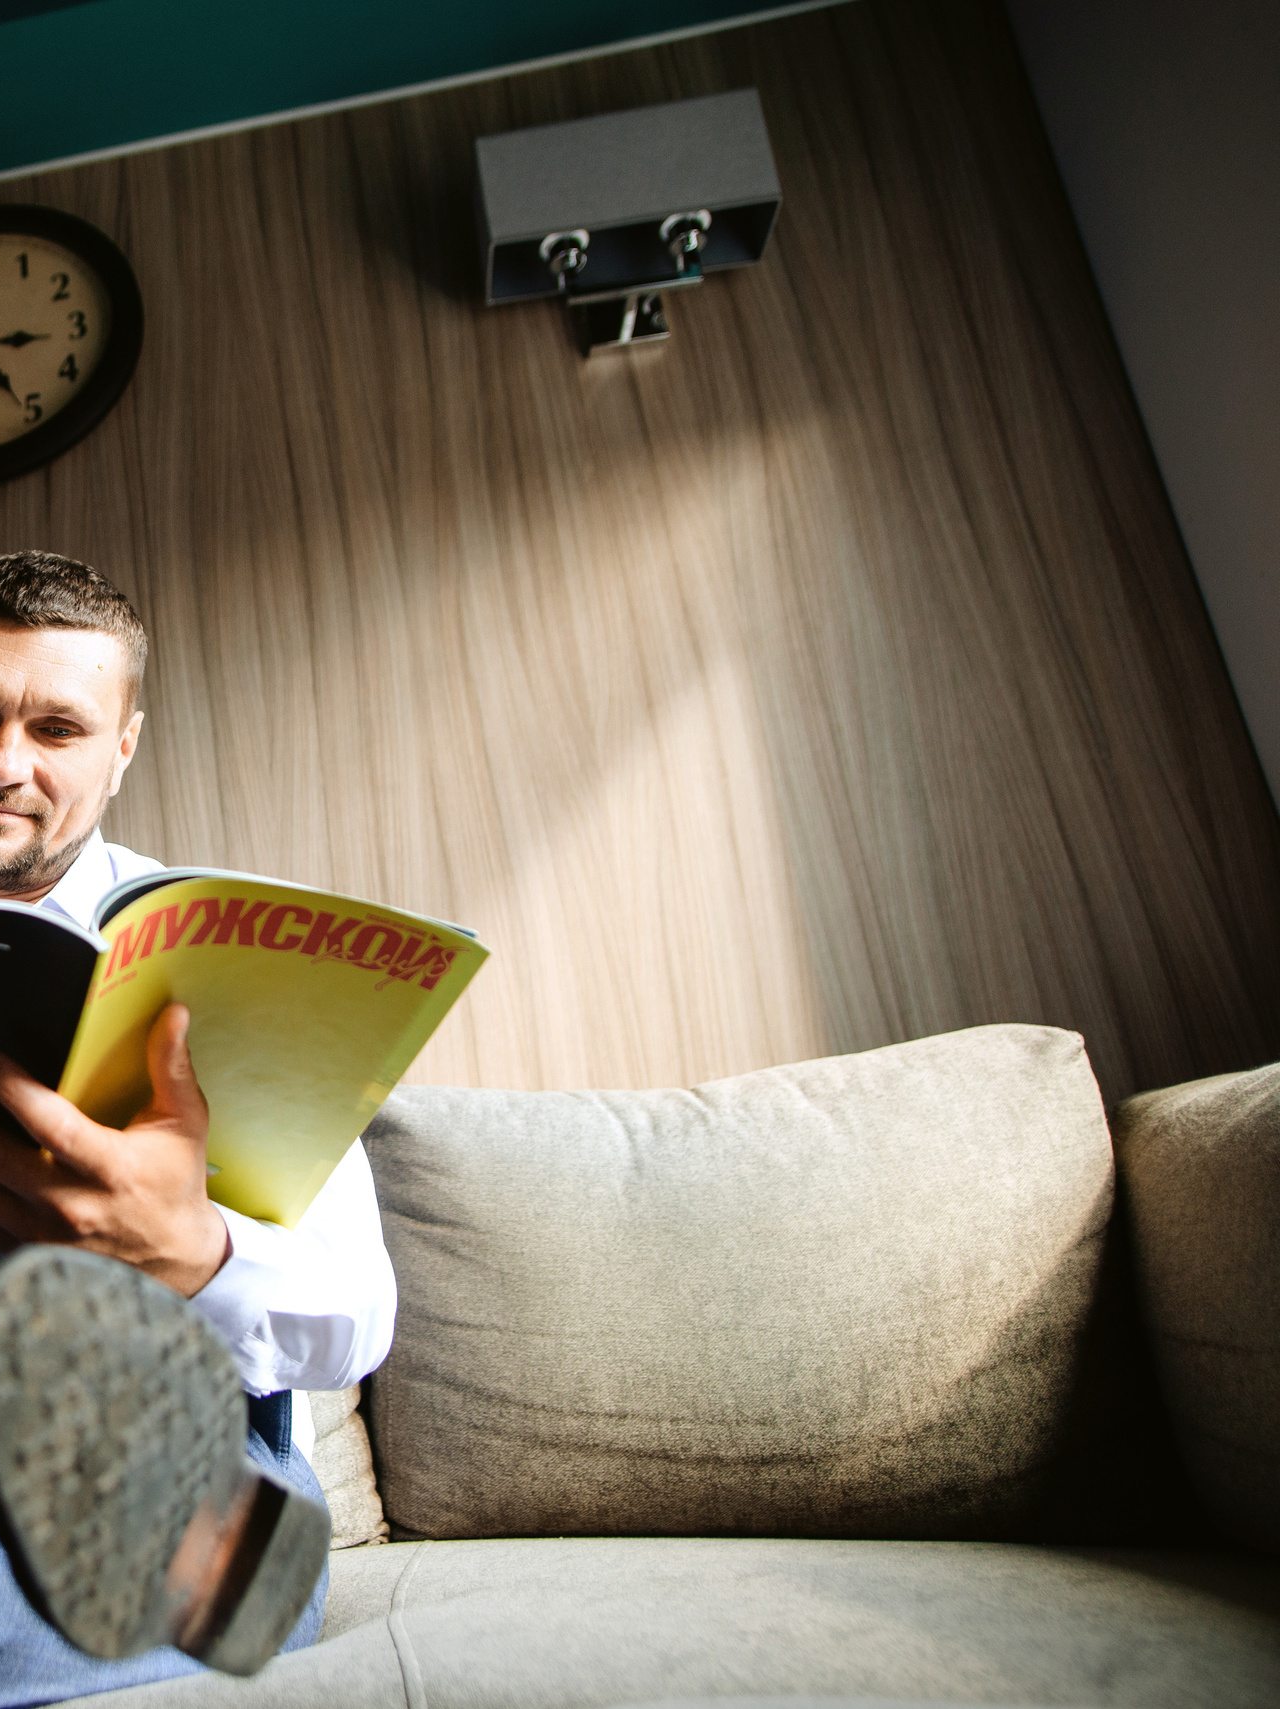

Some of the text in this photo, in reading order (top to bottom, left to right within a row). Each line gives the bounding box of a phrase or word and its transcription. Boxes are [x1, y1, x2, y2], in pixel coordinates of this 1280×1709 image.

[15, 253, 29, 279] 1
[51, 273, 70, 301] 2
[68, 310, 87, 339] 3
[58, 353, 78, 382] 4
[25, 394, 42, 424] 5
[103, 897, 458, 991] МУЖСКОЙ
